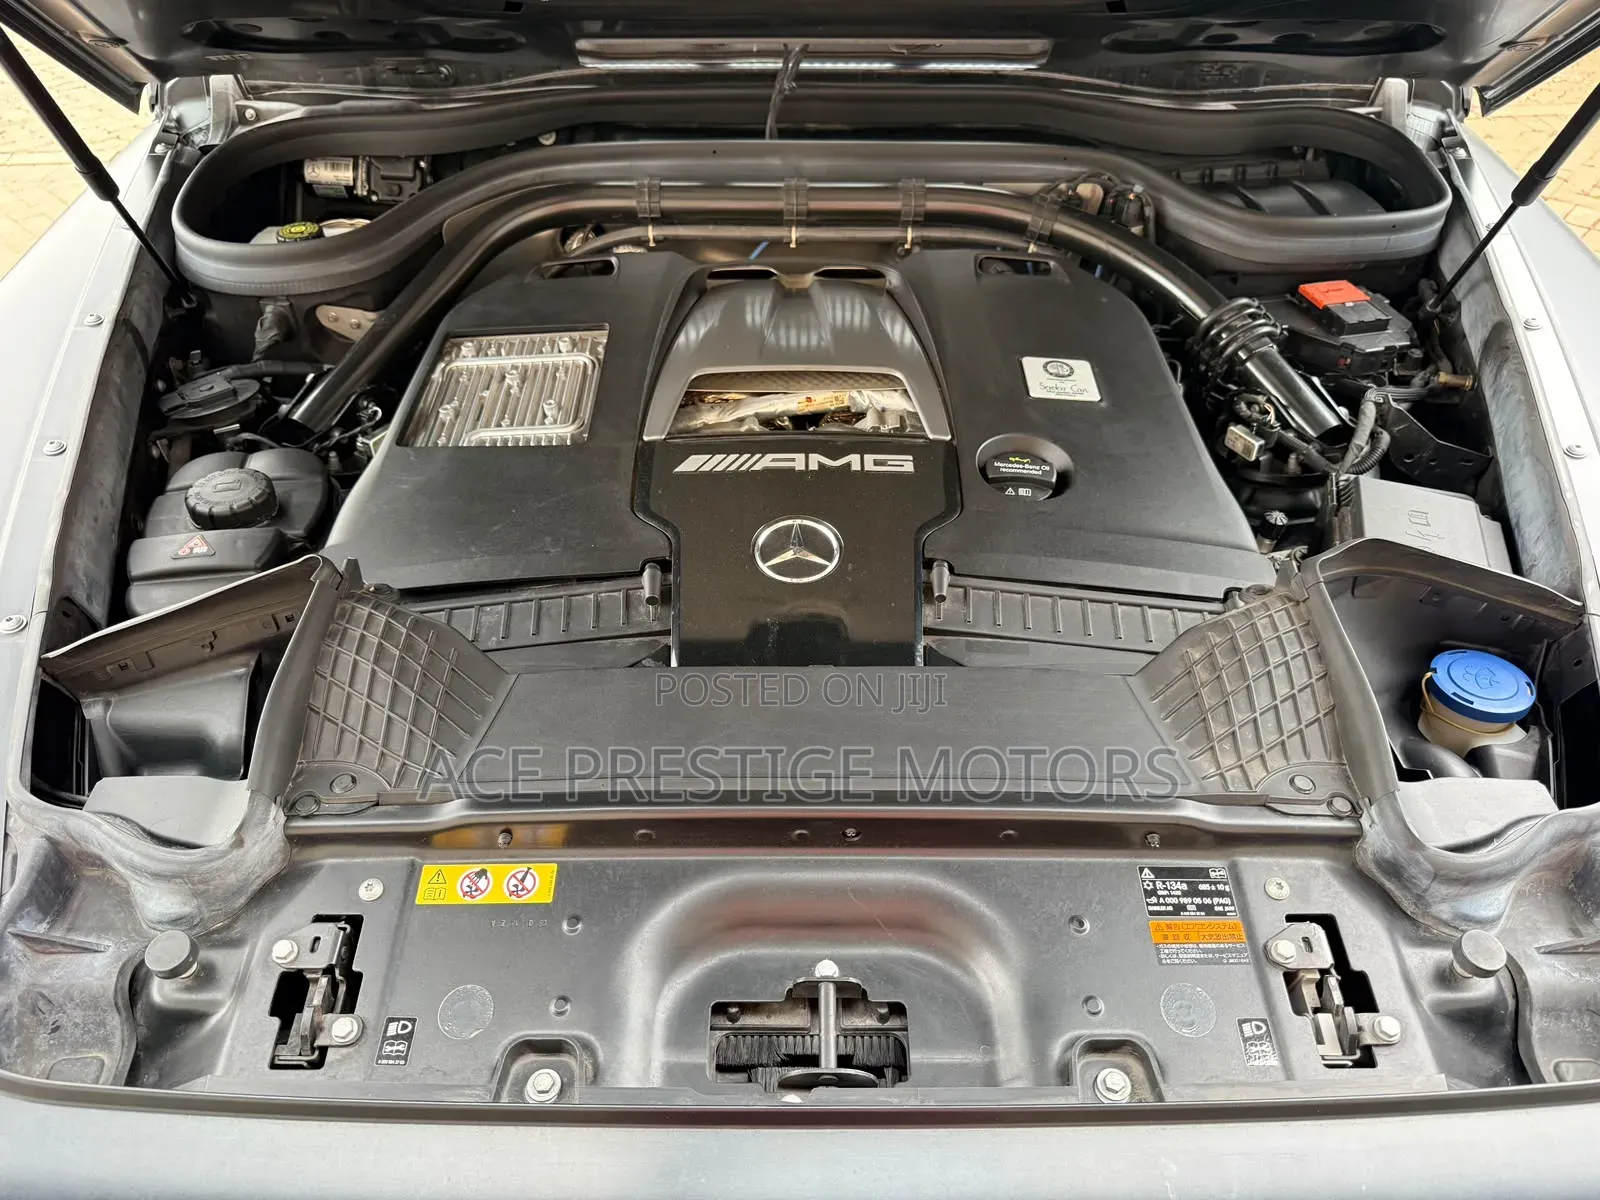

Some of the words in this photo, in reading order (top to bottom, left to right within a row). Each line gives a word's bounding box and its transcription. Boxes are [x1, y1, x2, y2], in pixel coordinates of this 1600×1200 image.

[749, 453, 915, 473] AMG
[994, 461, 1040, 470] Mercedes-Benz
[1000, 467, 1042, 475] recommended
[1155, 881, 1188, 890] R-134a
[1212, 897, 1231, 905] (PAG)
